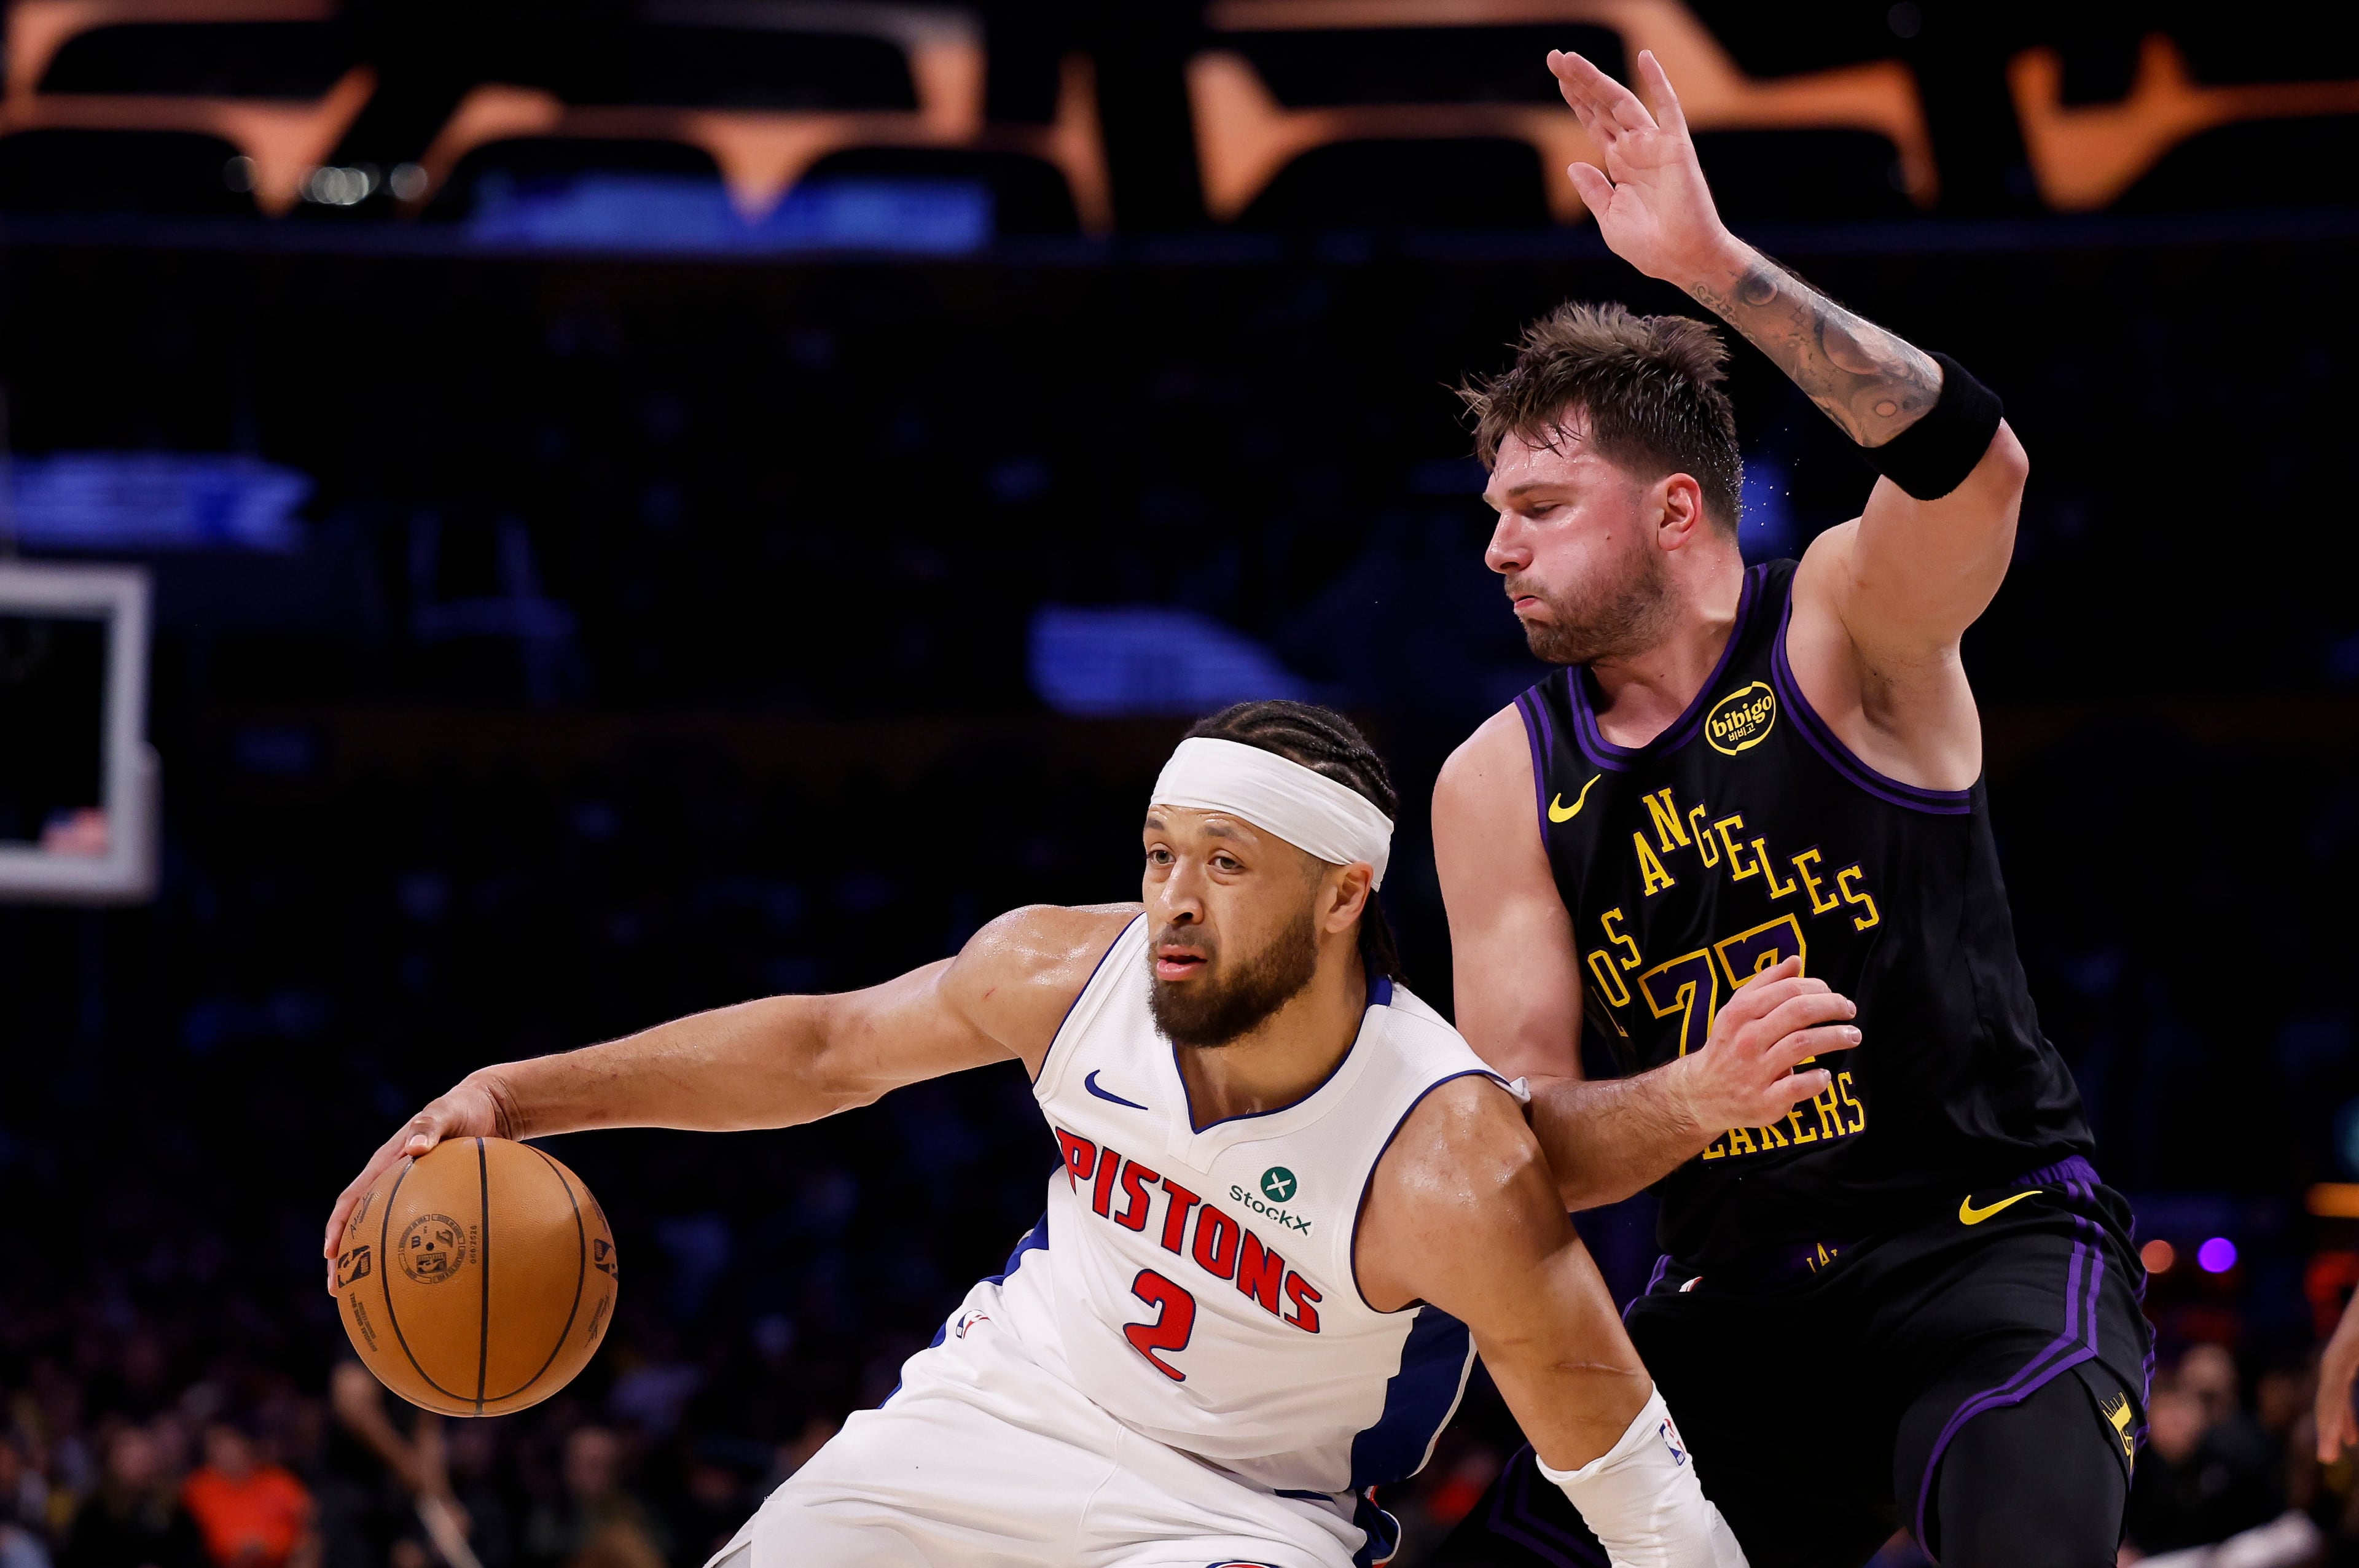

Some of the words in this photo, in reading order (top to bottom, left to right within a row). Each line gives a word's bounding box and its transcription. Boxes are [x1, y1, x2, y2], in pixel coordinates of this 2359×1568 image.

[1712, 695, 1772, 738] bibigo
[1727, 722, 1756, 742] 비비고
[1632, 786, 1880, 932] ANGELES
[1702, 1071, 1866, 1160] AERS
[1055, 1125, 1323, 1334] PISTONS
[1122, 1268, 1197, 1382] 2
